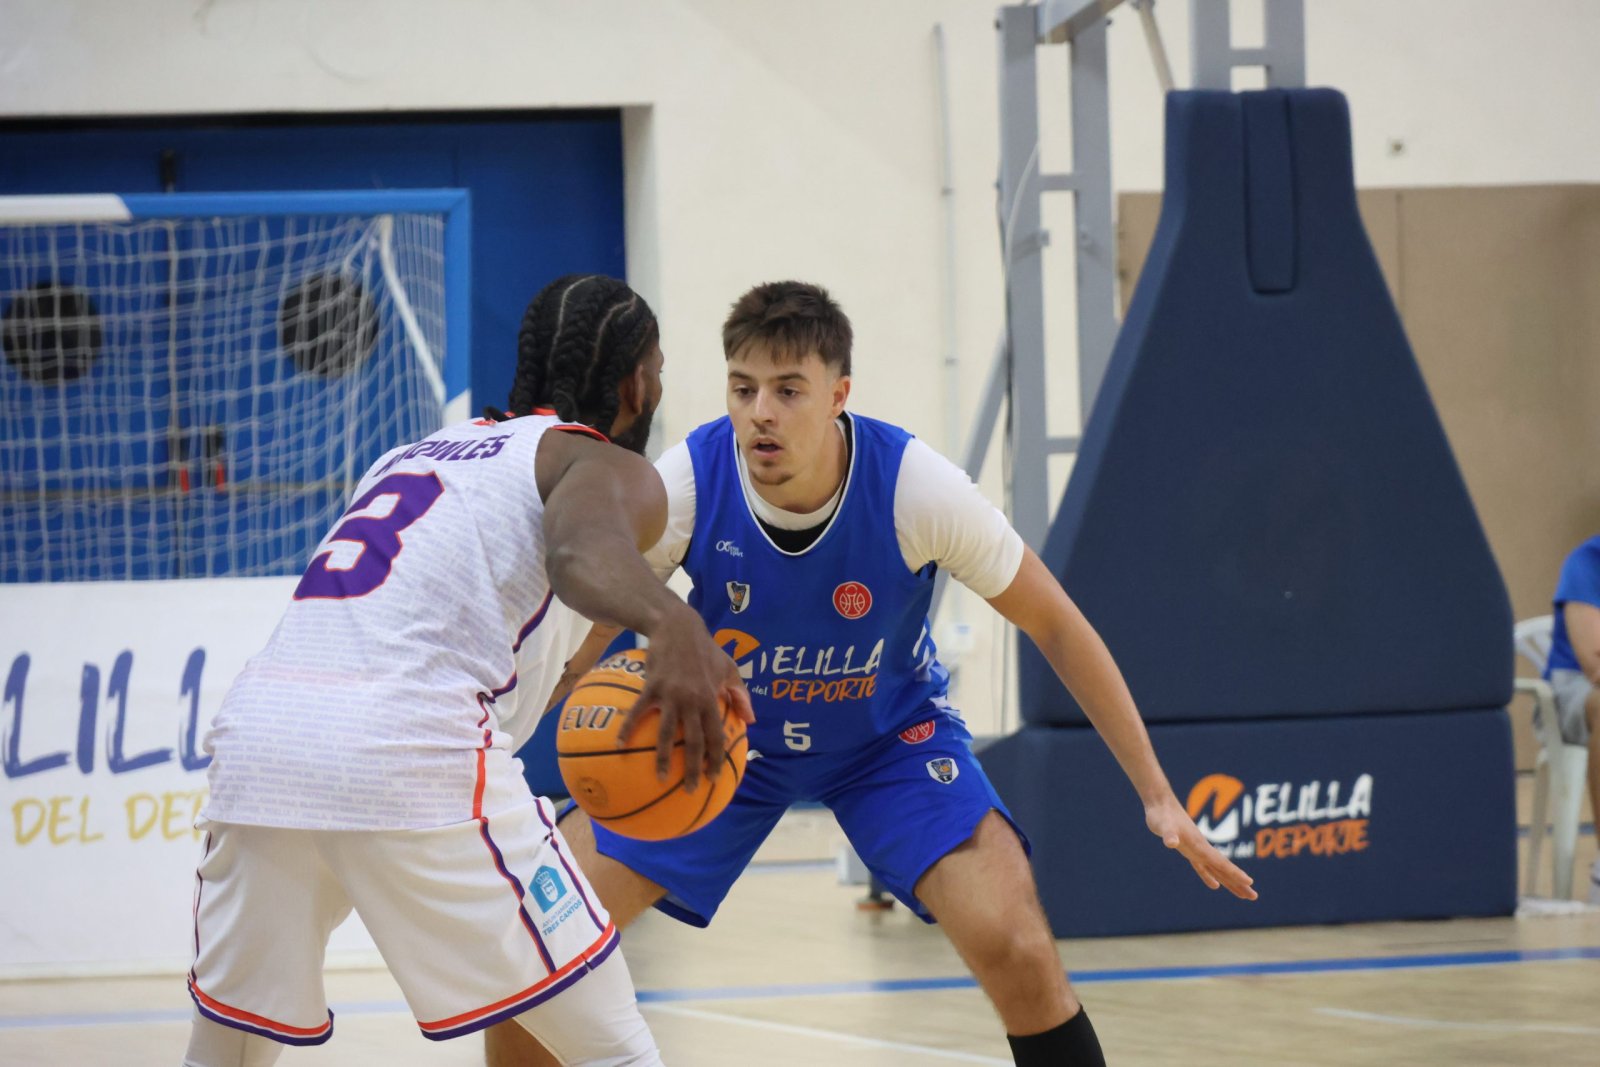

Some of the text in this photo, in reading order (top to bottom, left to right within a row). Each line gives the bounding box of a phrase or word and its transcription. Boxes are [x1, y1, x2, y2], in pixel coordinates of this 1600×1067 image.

[293, 470, 445, 600] 3
[771, 673, 878, 704] DEPORTE
[783, 720, 812, 751] 5
[11, 795, 104, 846] DEL
[1255, 818, 1371, 859] DEPORTE
[559, 898, 583, 922] CANTOS
